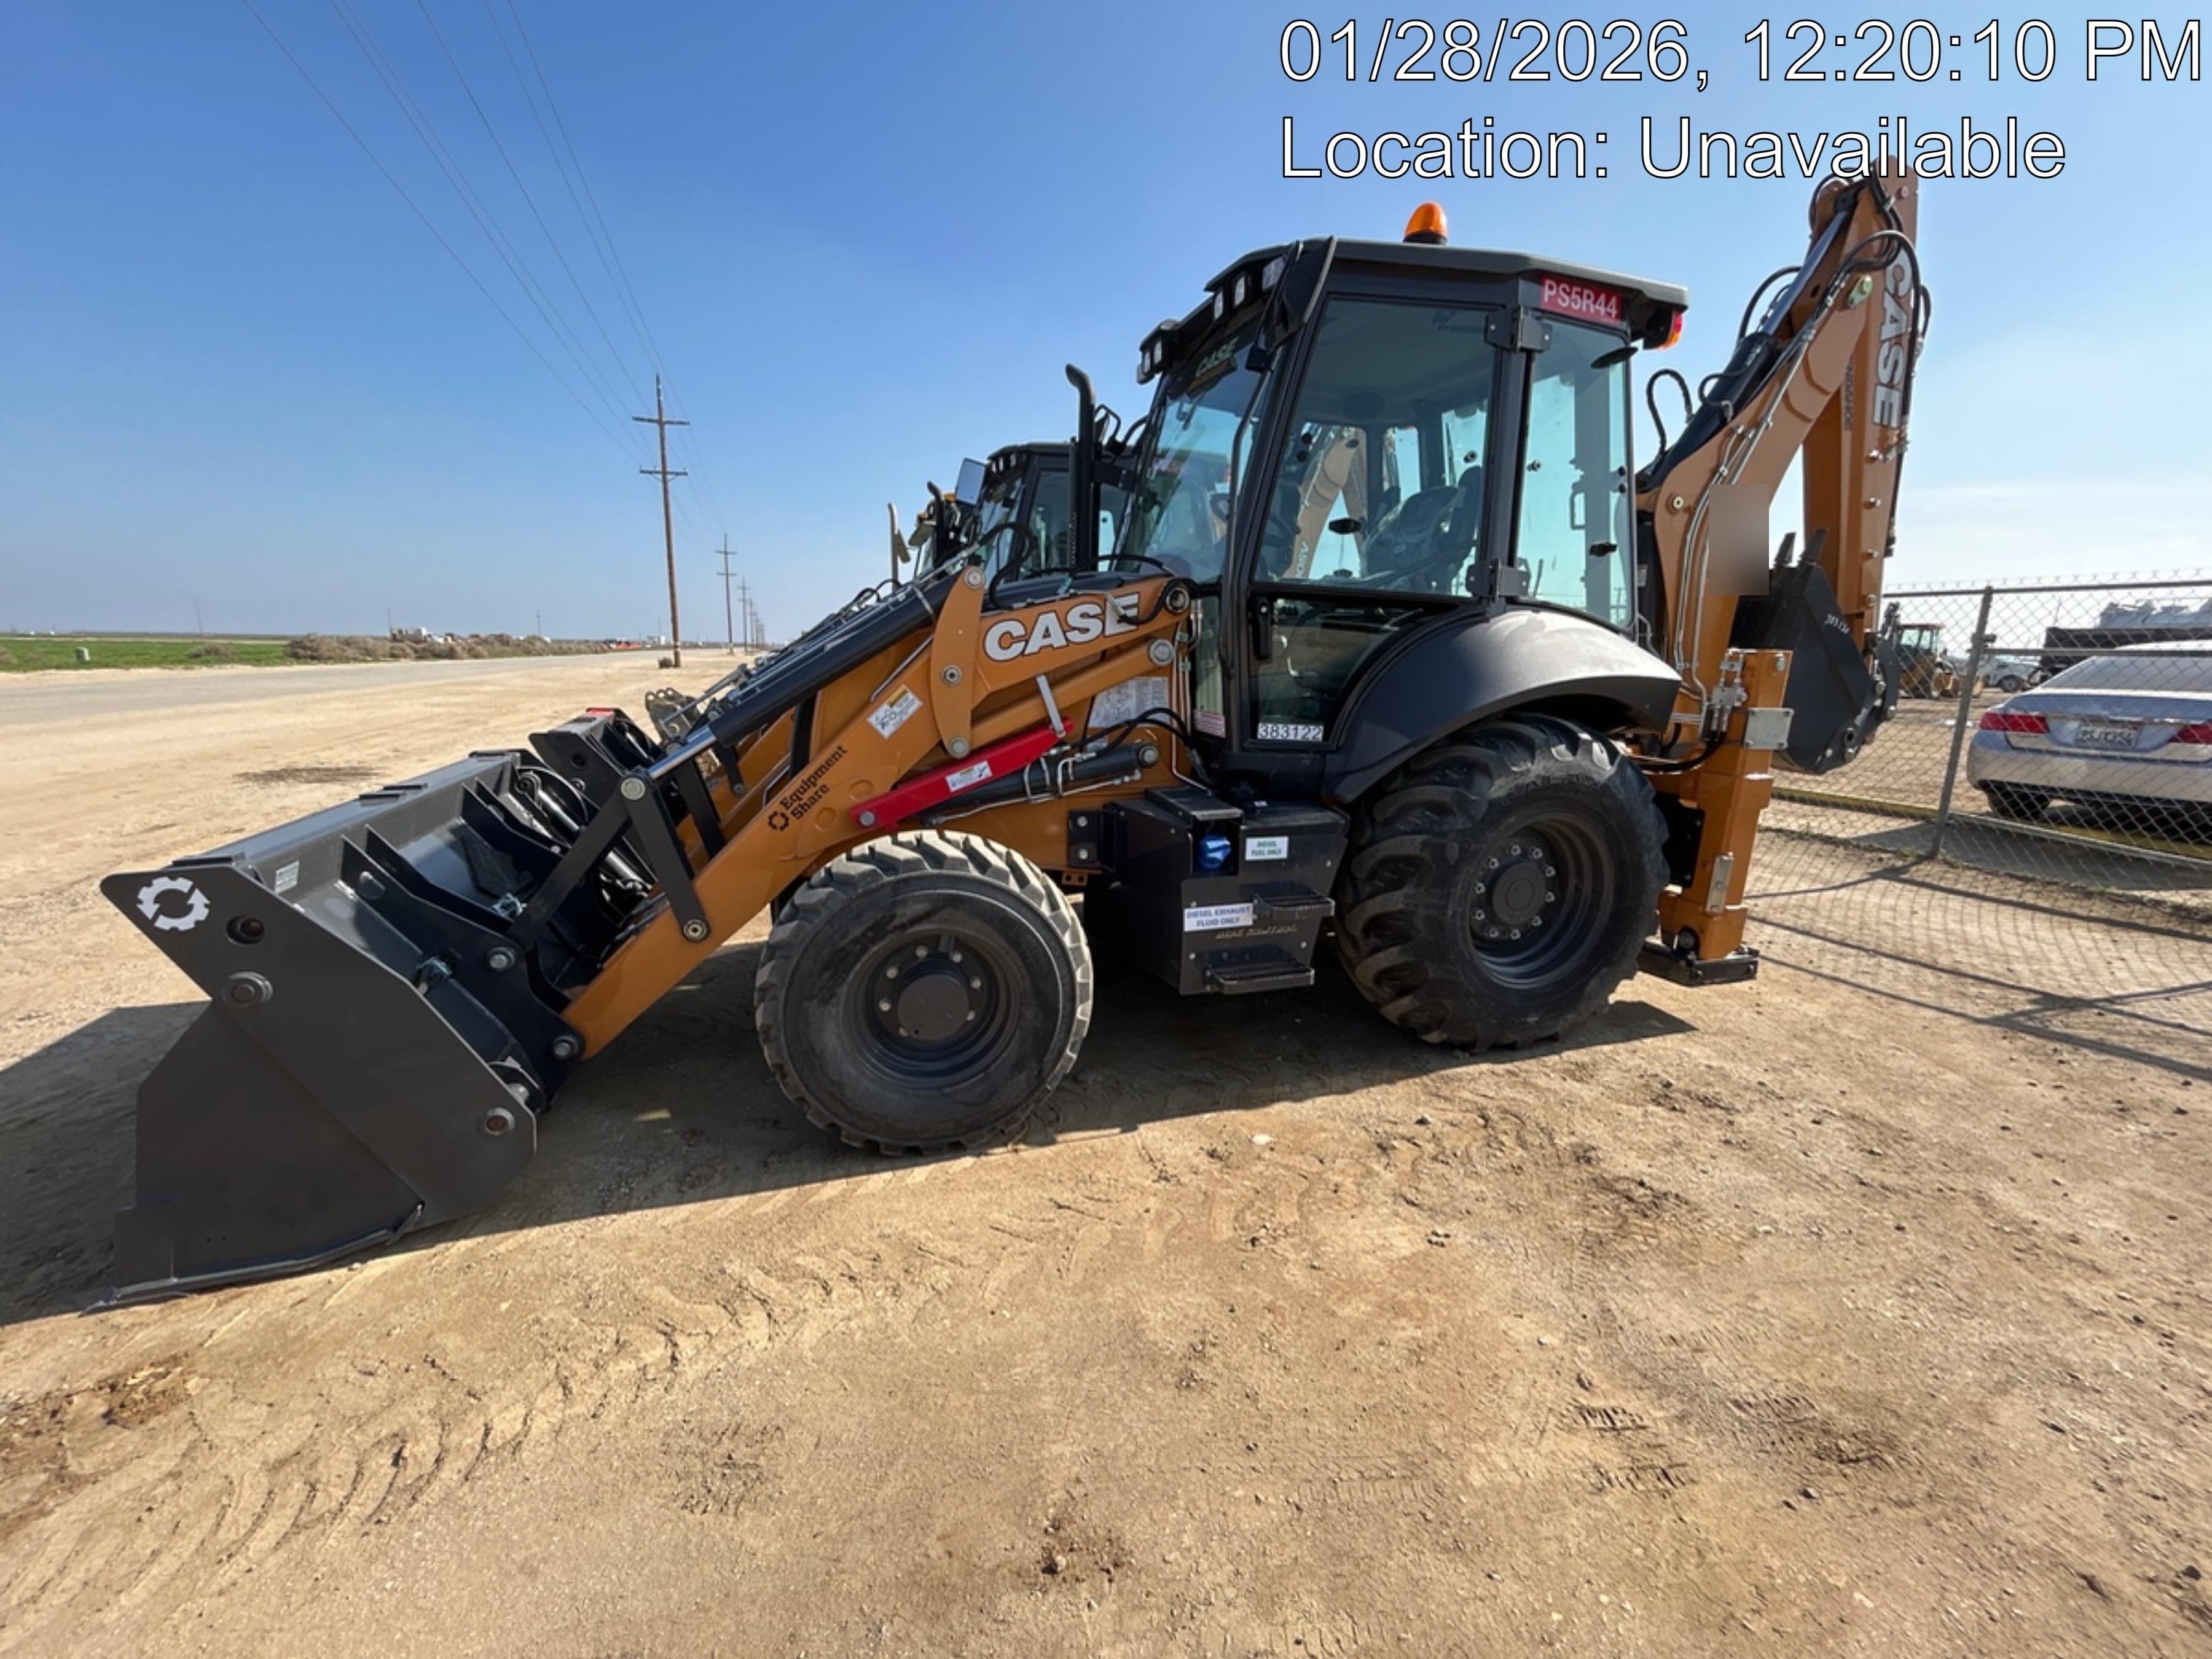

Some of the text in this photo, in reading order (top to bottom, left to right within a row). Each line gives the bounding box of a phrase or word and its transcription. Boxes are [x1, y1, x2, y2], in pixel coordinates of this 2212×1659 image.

[1543, 278, 1618, 318] PS5R44
[1873, 247, 1914, 428] CASE
[982, 592, 1140, 662] CASE
[1258, 723, 1323, 741] 383122
[779, 745, 849, 810] Equipment
[790, 784, 830, 820] Share
[1186, 906, 1250, 919] DIESEL EXHAUST
[1196, 916, 1241, 927] FLUID ONLY
